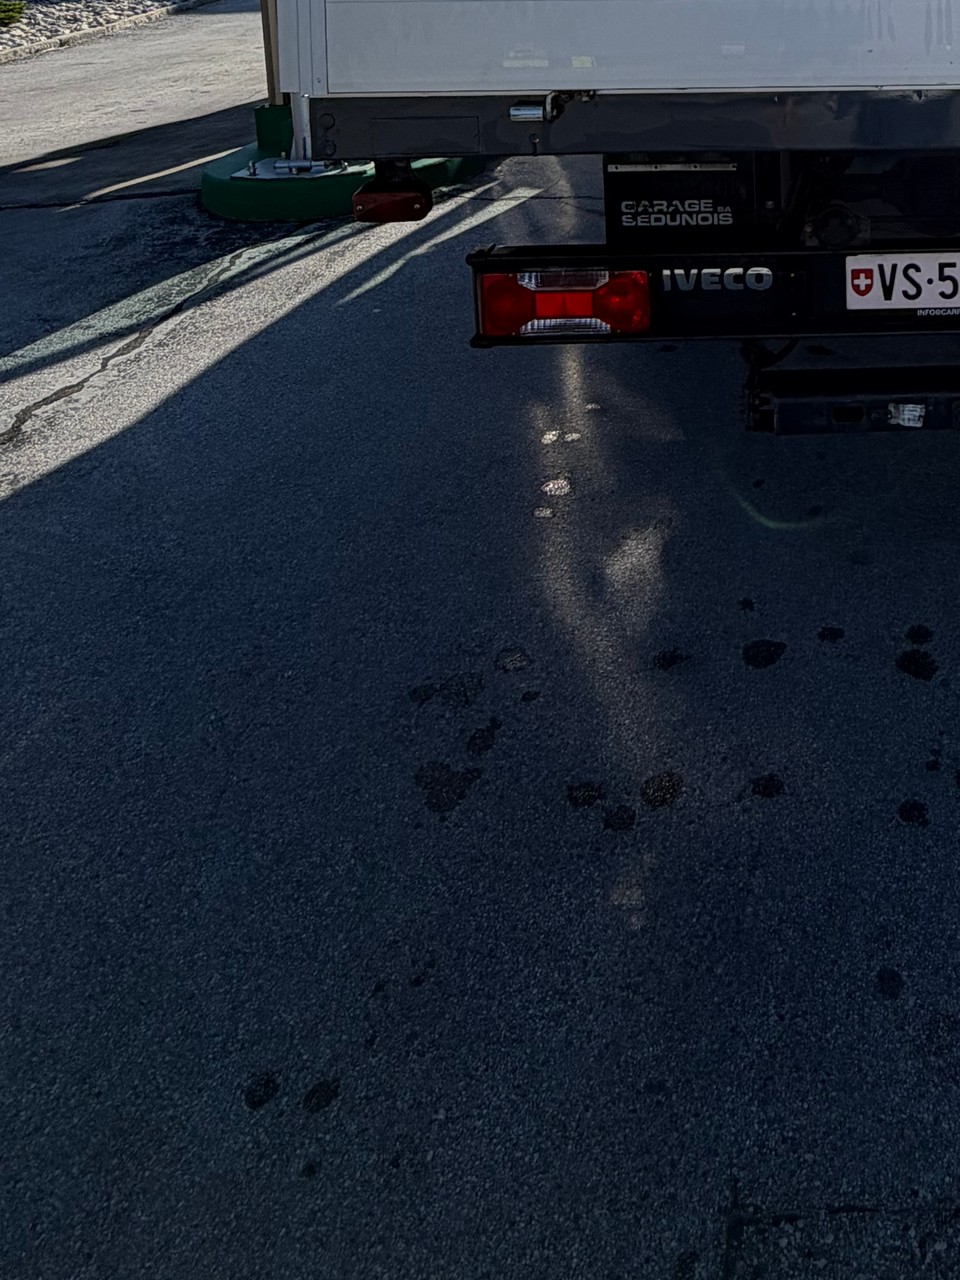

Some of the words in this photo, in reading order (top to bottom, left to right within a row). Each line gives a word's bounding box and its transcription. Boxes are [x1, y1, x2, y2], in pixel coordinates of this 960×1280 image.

[621, 199, 713, 213] GARAGE
[621, 213, 733, 227] SEDUNOIS
[662, 267, 773, 291] IVECO
